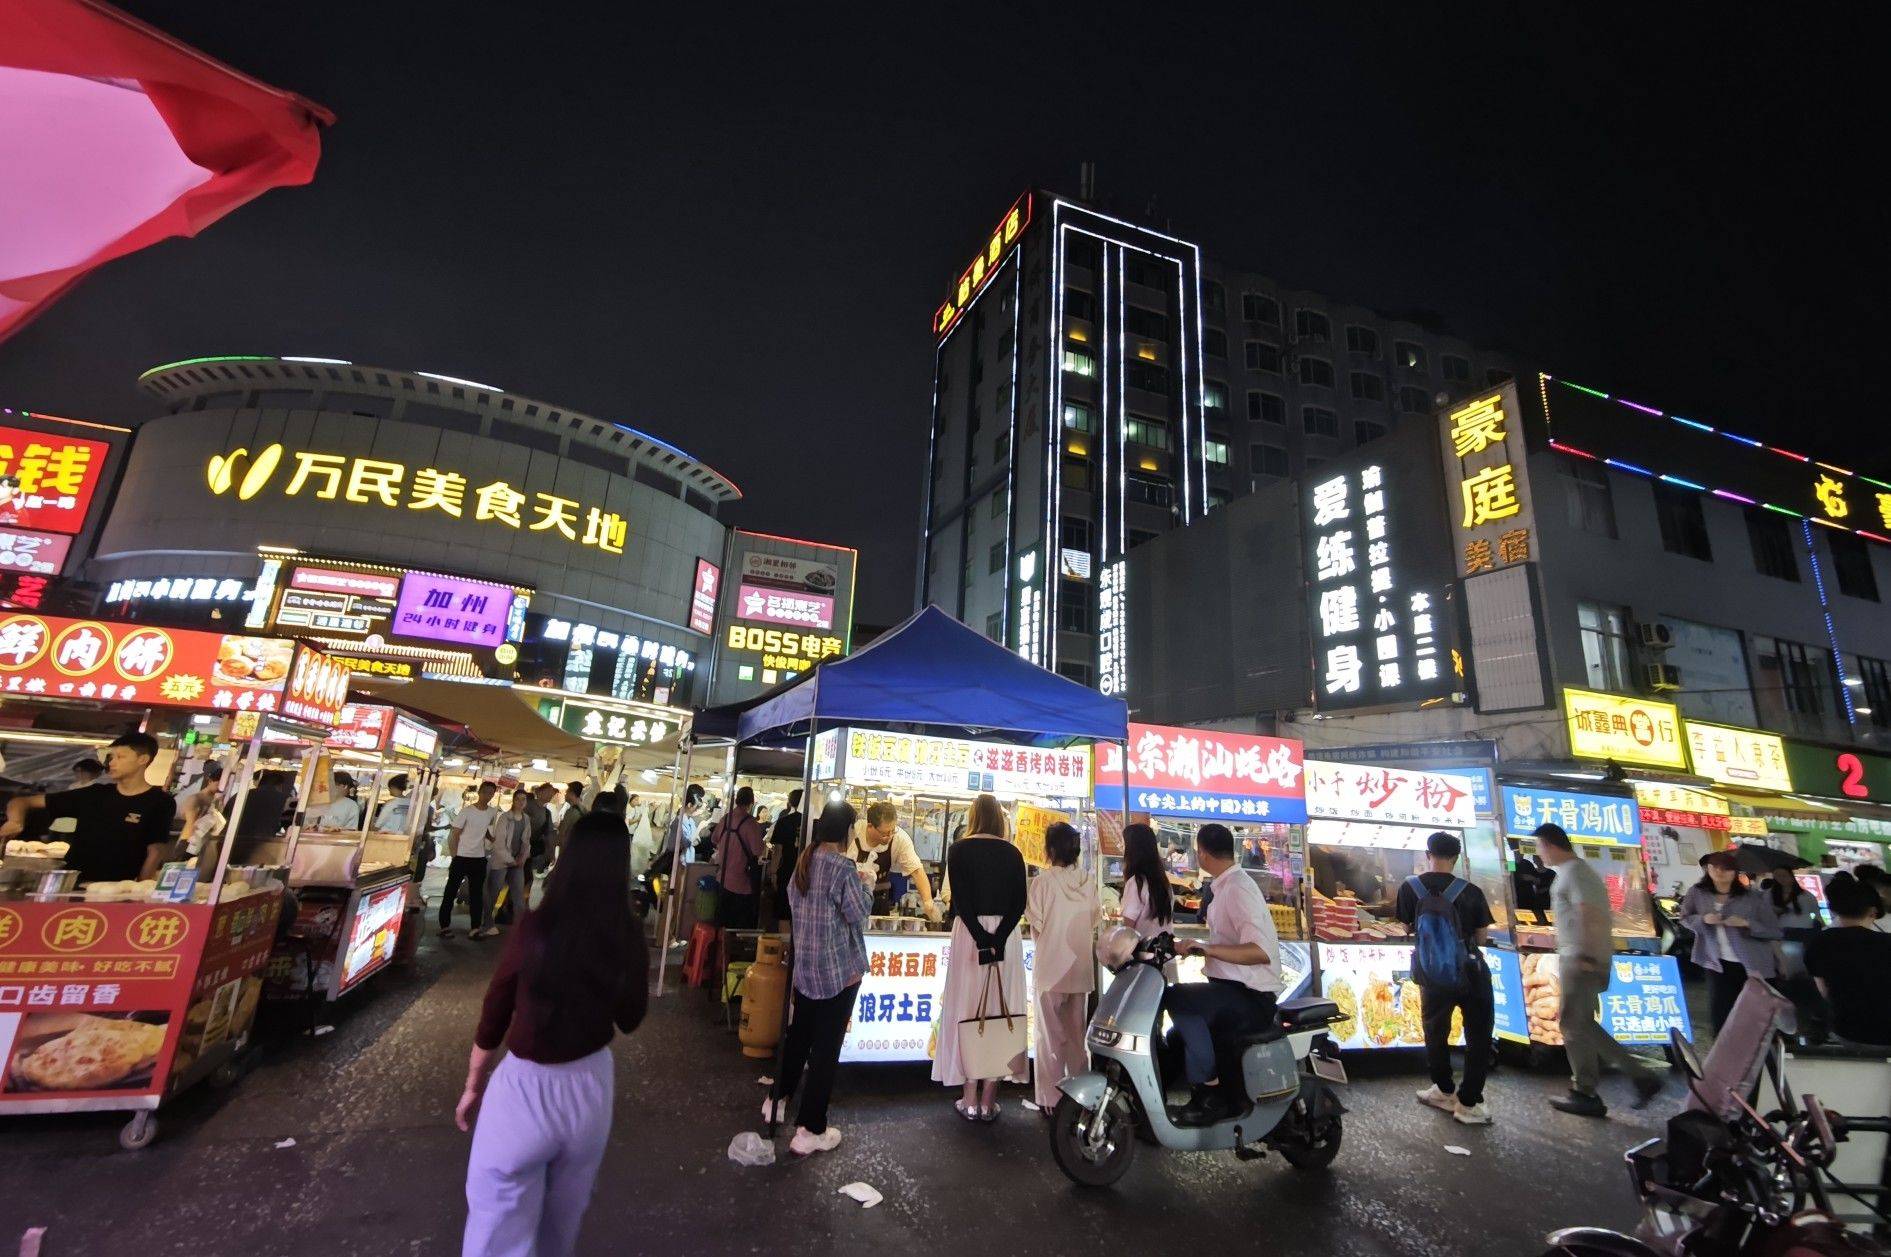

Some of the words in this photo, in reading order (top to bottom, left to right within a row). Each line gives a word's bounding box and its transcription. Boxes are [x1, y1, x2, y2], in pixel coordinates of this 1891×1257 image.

[1450, 394, 1520, 529] 豪庭
[285, 451, 628, 555] 万民美食天地
[1313, 475, 1363, 695] 爱练健身
[423, 588, 489, 615] 加州
[402, 612, 498, 635] 24小时健身
[1837, 752, 1870, 799] 2
[0, 914, 181, 946] 肉饼
[869, 951, 938, 978] 铁板豆腐
[0, 983, 121, 1006] 口齿留香
[858, 992, 933, 1023] 狼牙土豆
[1607, 994, 1681, 1015] 无骨鸡爪
